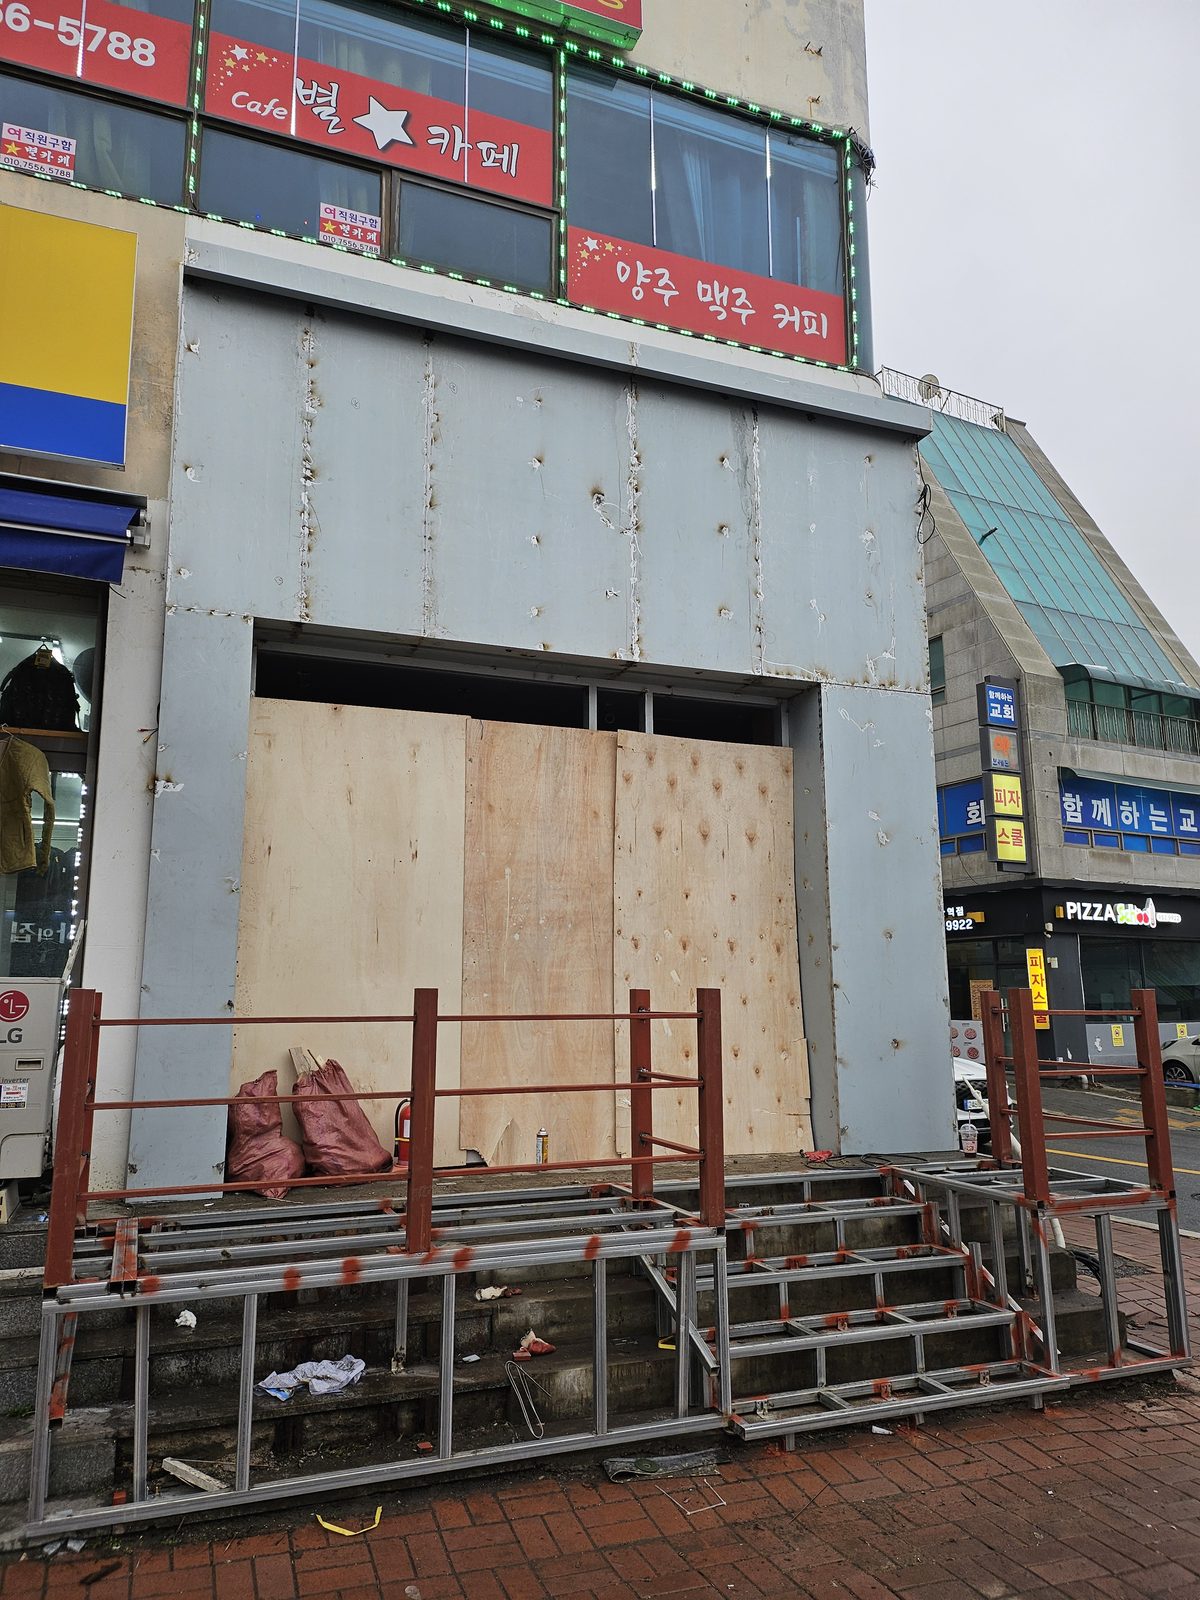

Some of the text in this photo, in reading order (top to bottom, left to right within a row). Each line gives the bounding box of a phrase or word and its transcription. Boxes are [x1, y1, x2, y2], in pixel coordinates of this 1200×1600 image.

[231, 77, 519, 178] Cafe 별 카페
[7, 127, 72, 152] 여 직원구함
[324, 206, 378, 228] 여 직원구함
[616, 260, 828, 339] 양주 맥주 커피
[988, 690, 1013, 702] 함께하는
[990, 702, 1015, 722] 교회
[994, 788, 1021, 808] 피자
[997, 828, 1024, 847] 스쿨
[943, 906, 964, 917] 역점
[1065, 901, 1117, 922] PIZZA
